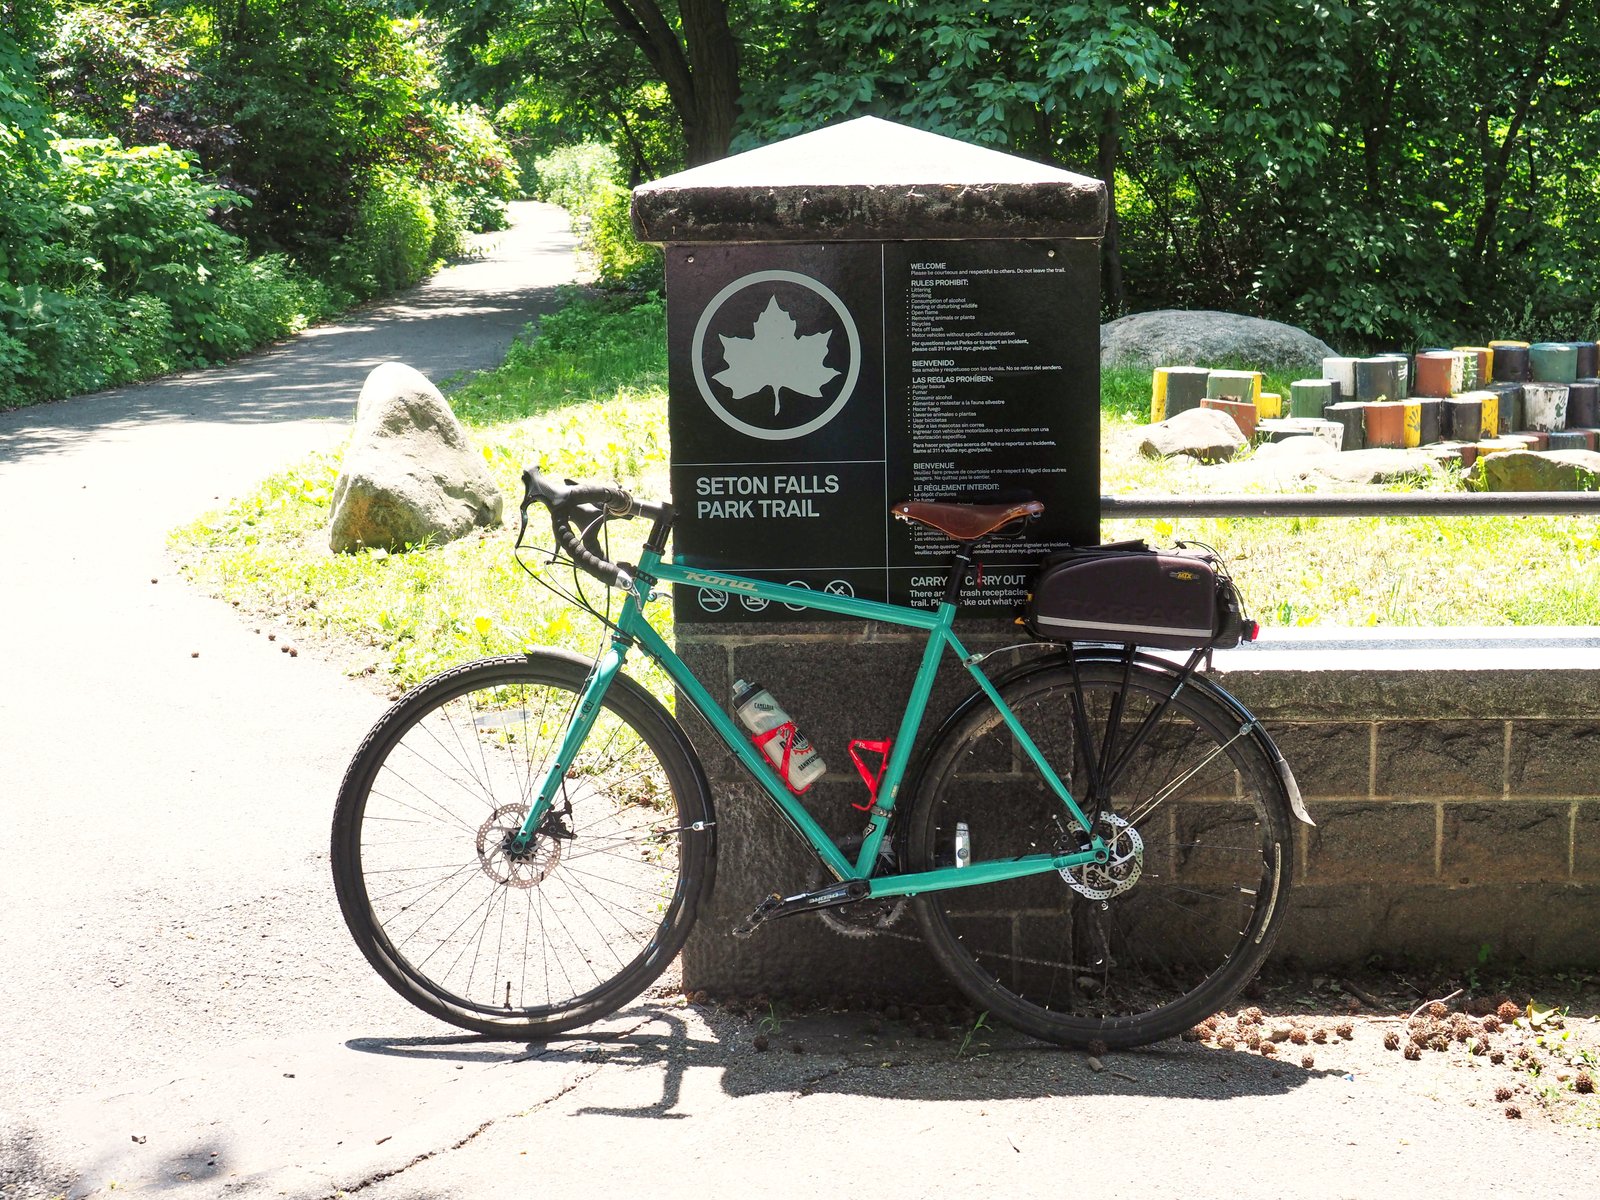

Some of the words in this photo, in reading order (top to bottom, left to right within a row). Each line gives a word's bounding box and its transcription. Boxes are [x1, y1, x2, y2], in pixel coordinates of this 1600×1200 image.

[956, 374, 993, 382] PROHÍBEN:
[696, 476, 768, 495] SETON
[774, 475, 839, 494] FALLS
[697, 501, 754, 518] PARK
[758, 499, 820, 517] TRAIL
[910, 576, 948, 586] CARRY
[964, 575, 1002, 586] CRRY
[1003, 575, 1026, 585] OUT
[982, 588, 1028, 597] receptacles
